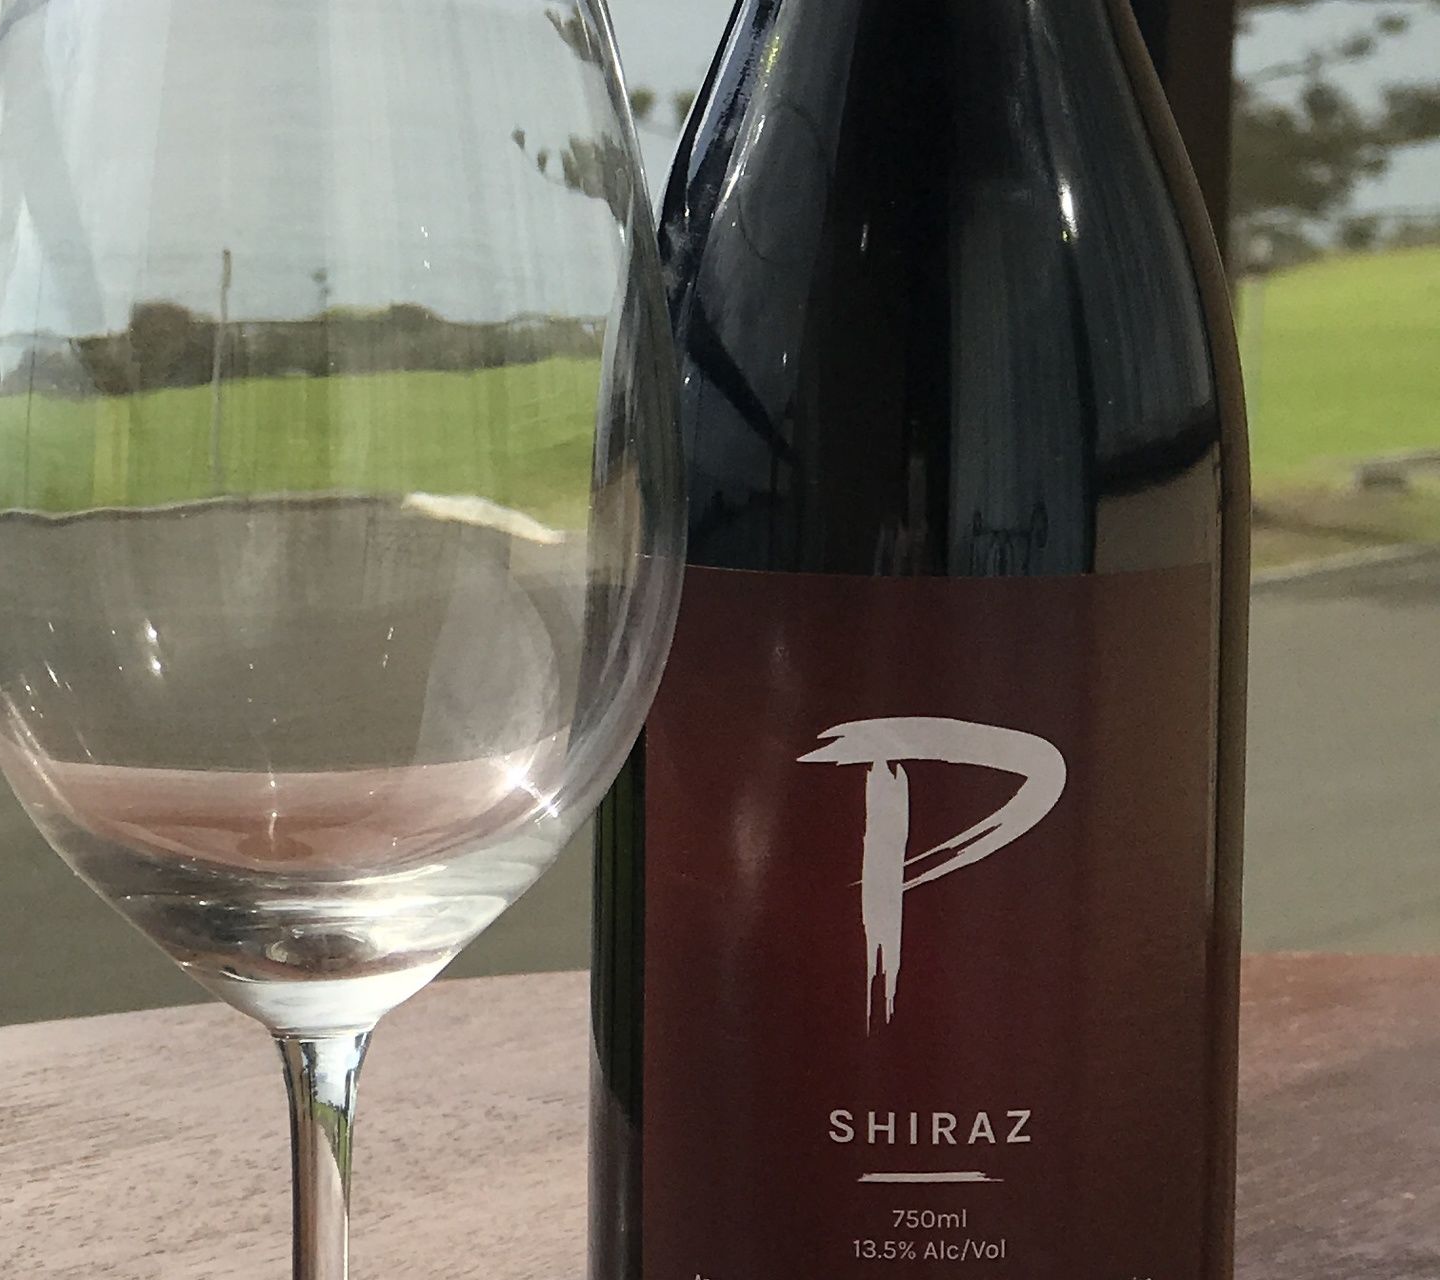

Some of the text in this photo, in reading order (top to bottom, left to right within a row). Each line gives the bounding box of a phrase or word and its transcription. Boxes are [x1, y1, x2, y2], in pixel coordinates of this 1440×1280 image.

[796, 716, 1067, 1037] P
[828, 1109, 1032, 1145] SHIRAZ
[892, 1208, 967, 1229] 750ml
[852, 1238, 1006, 1262] 13.5% Alc/Vol
